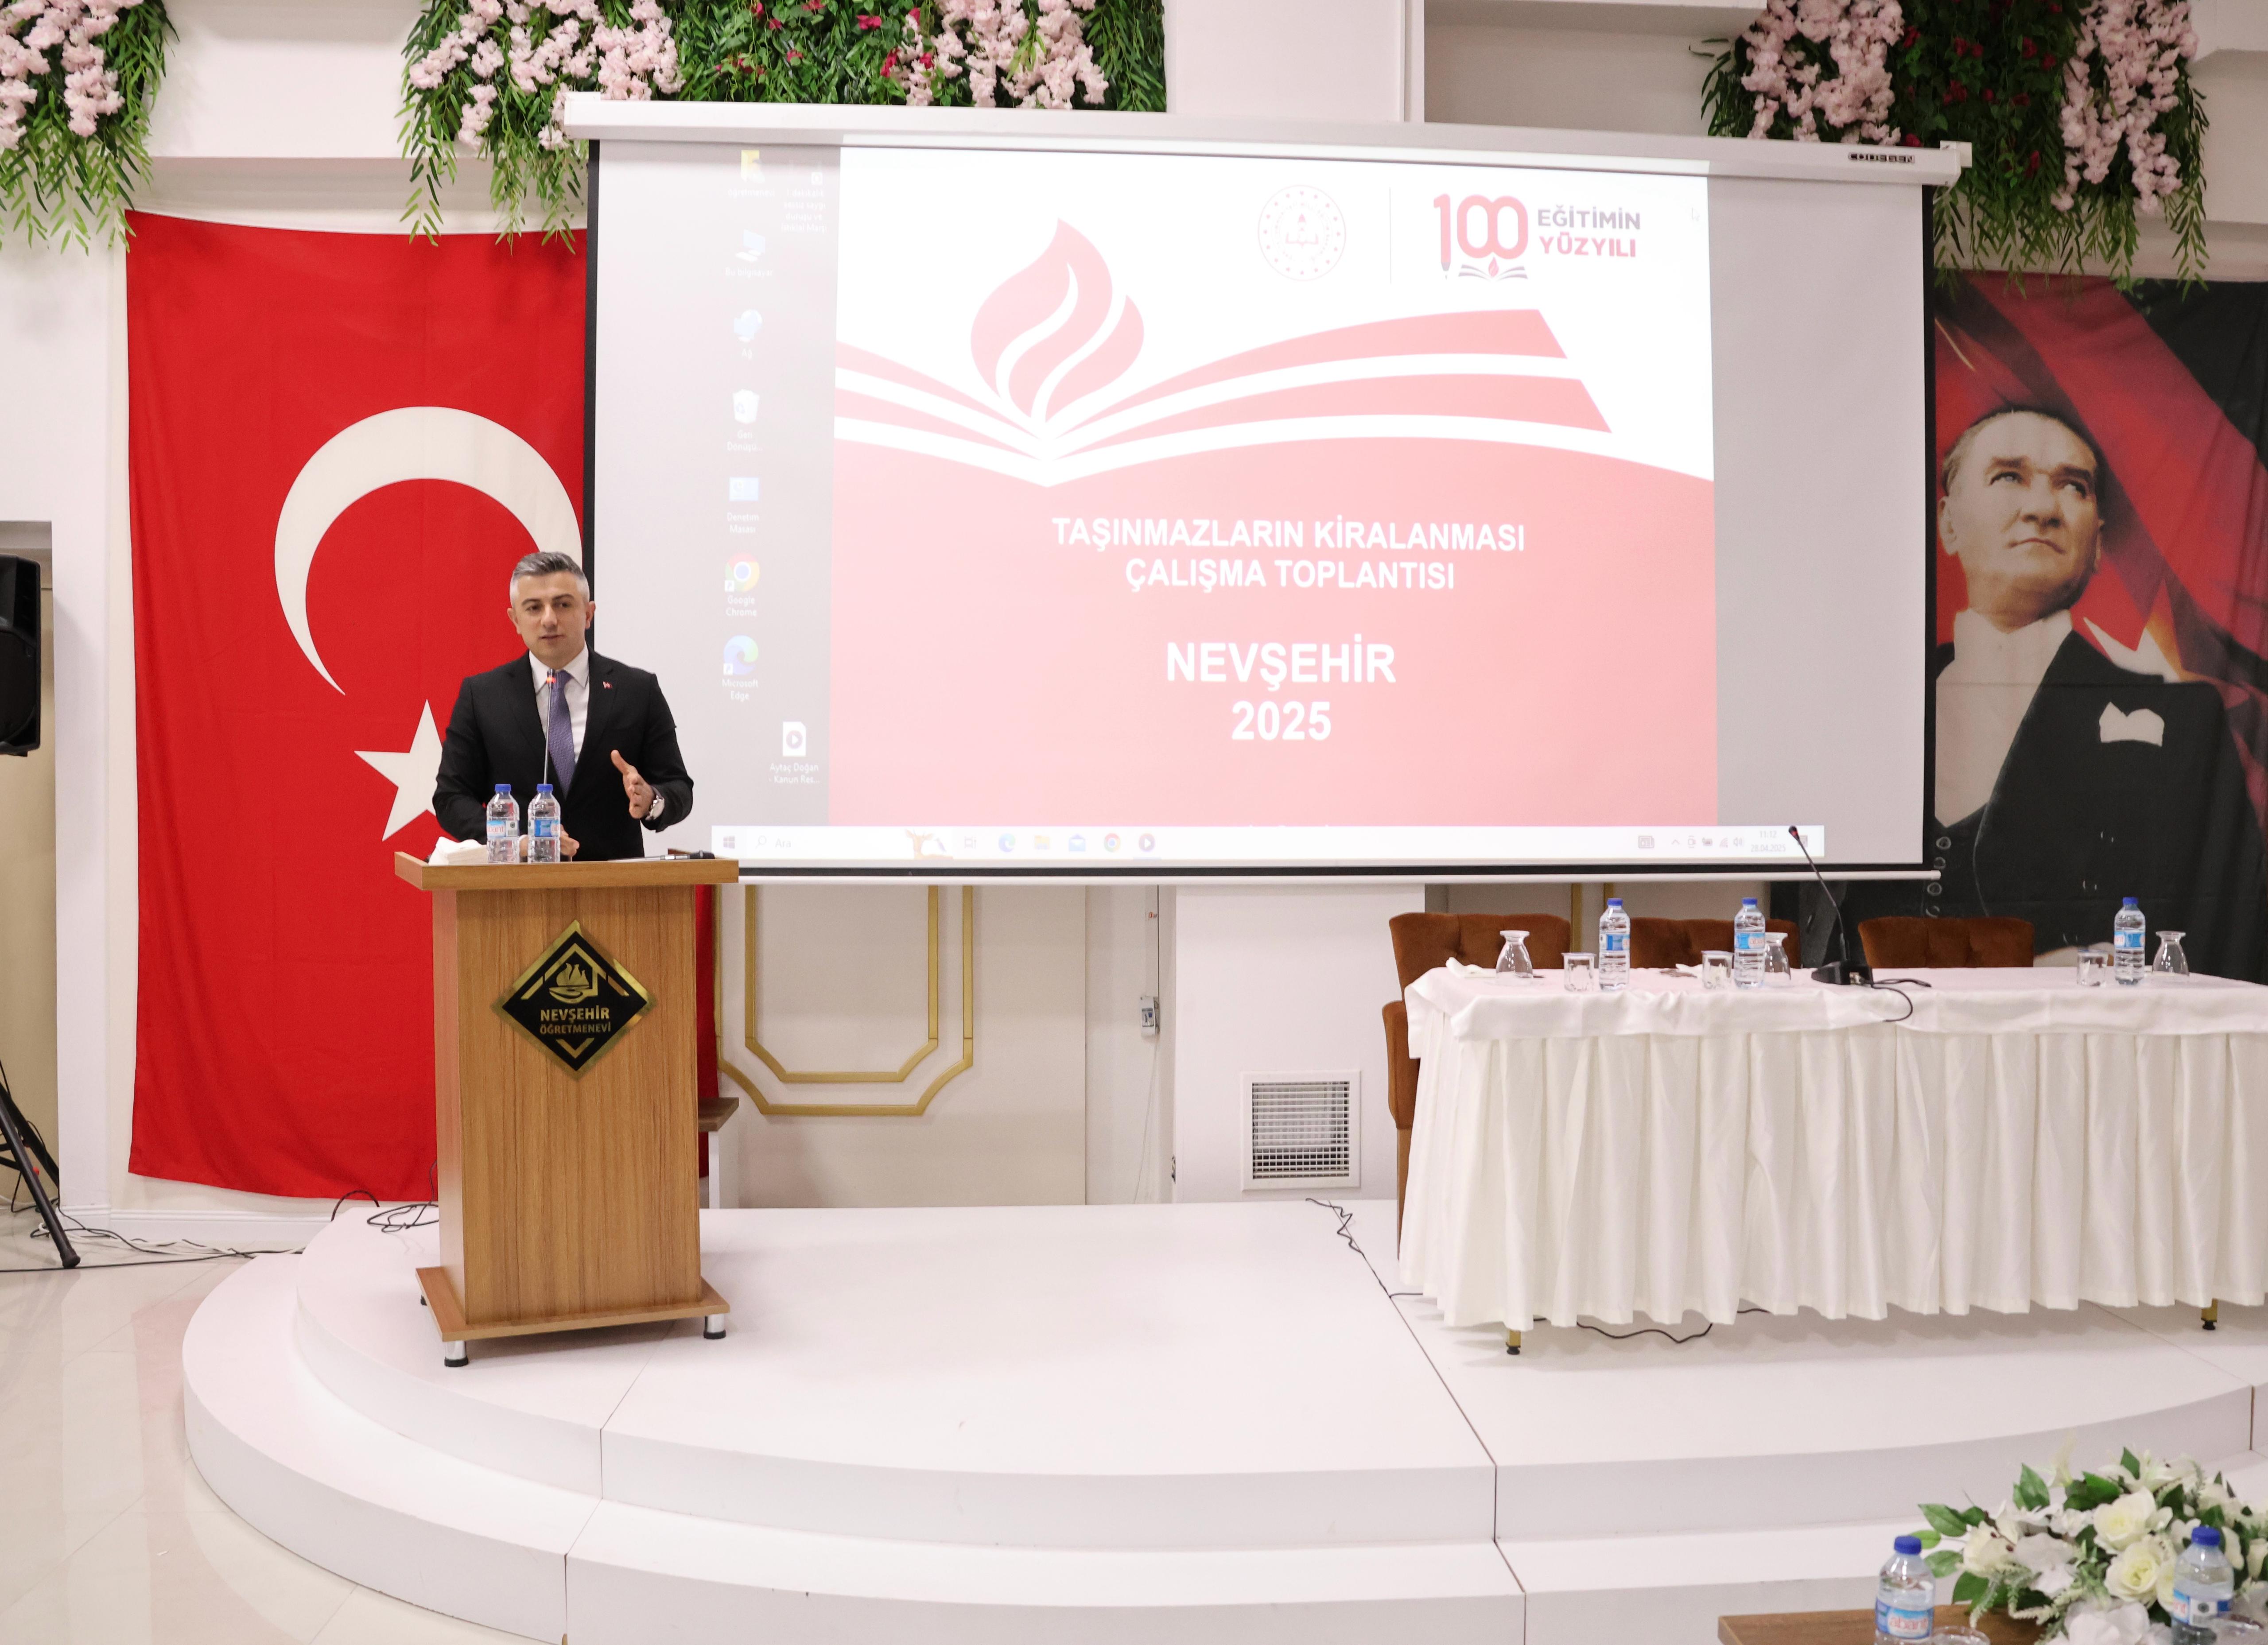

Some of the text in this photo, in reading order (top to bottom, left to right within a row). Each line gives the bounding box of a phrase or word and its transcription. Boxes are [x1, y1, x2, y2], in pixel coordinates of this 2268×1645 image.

[1434, 194, 1641, 268] 100 EĞİTİMİN
[1539, 232, 1637, 258] YÜZYILI
[727, 512, 760, 522] Denetim
[730, 525, 756, 534] Masası
[1052, 515, 1525, 553] TAŞINMAZLARIN KİRALANMASI
[1126, 558, 1455, 593] ÇALIŞMA TOPLANTISI
[727, 595, 756, 607] Google
[726, 607, 757, 617] Chrome
[1167, 633, 1397, 692] NEVŞEHİR
[722, 679, 759, 689] Microsoft
[730, 691, 750, 702] Edge
[1231, 701, 1332, 741] 2025
[769, 762, 819, 775] Aytaç Doğan
[774, 775, 799, 784] Kanun
[775, 838, 792, 848] Ara
[540, 1005, 610, 1024] NEVŞEHİR
[540, 1021, 611, 1035] ÖĞRETMENEVİ
